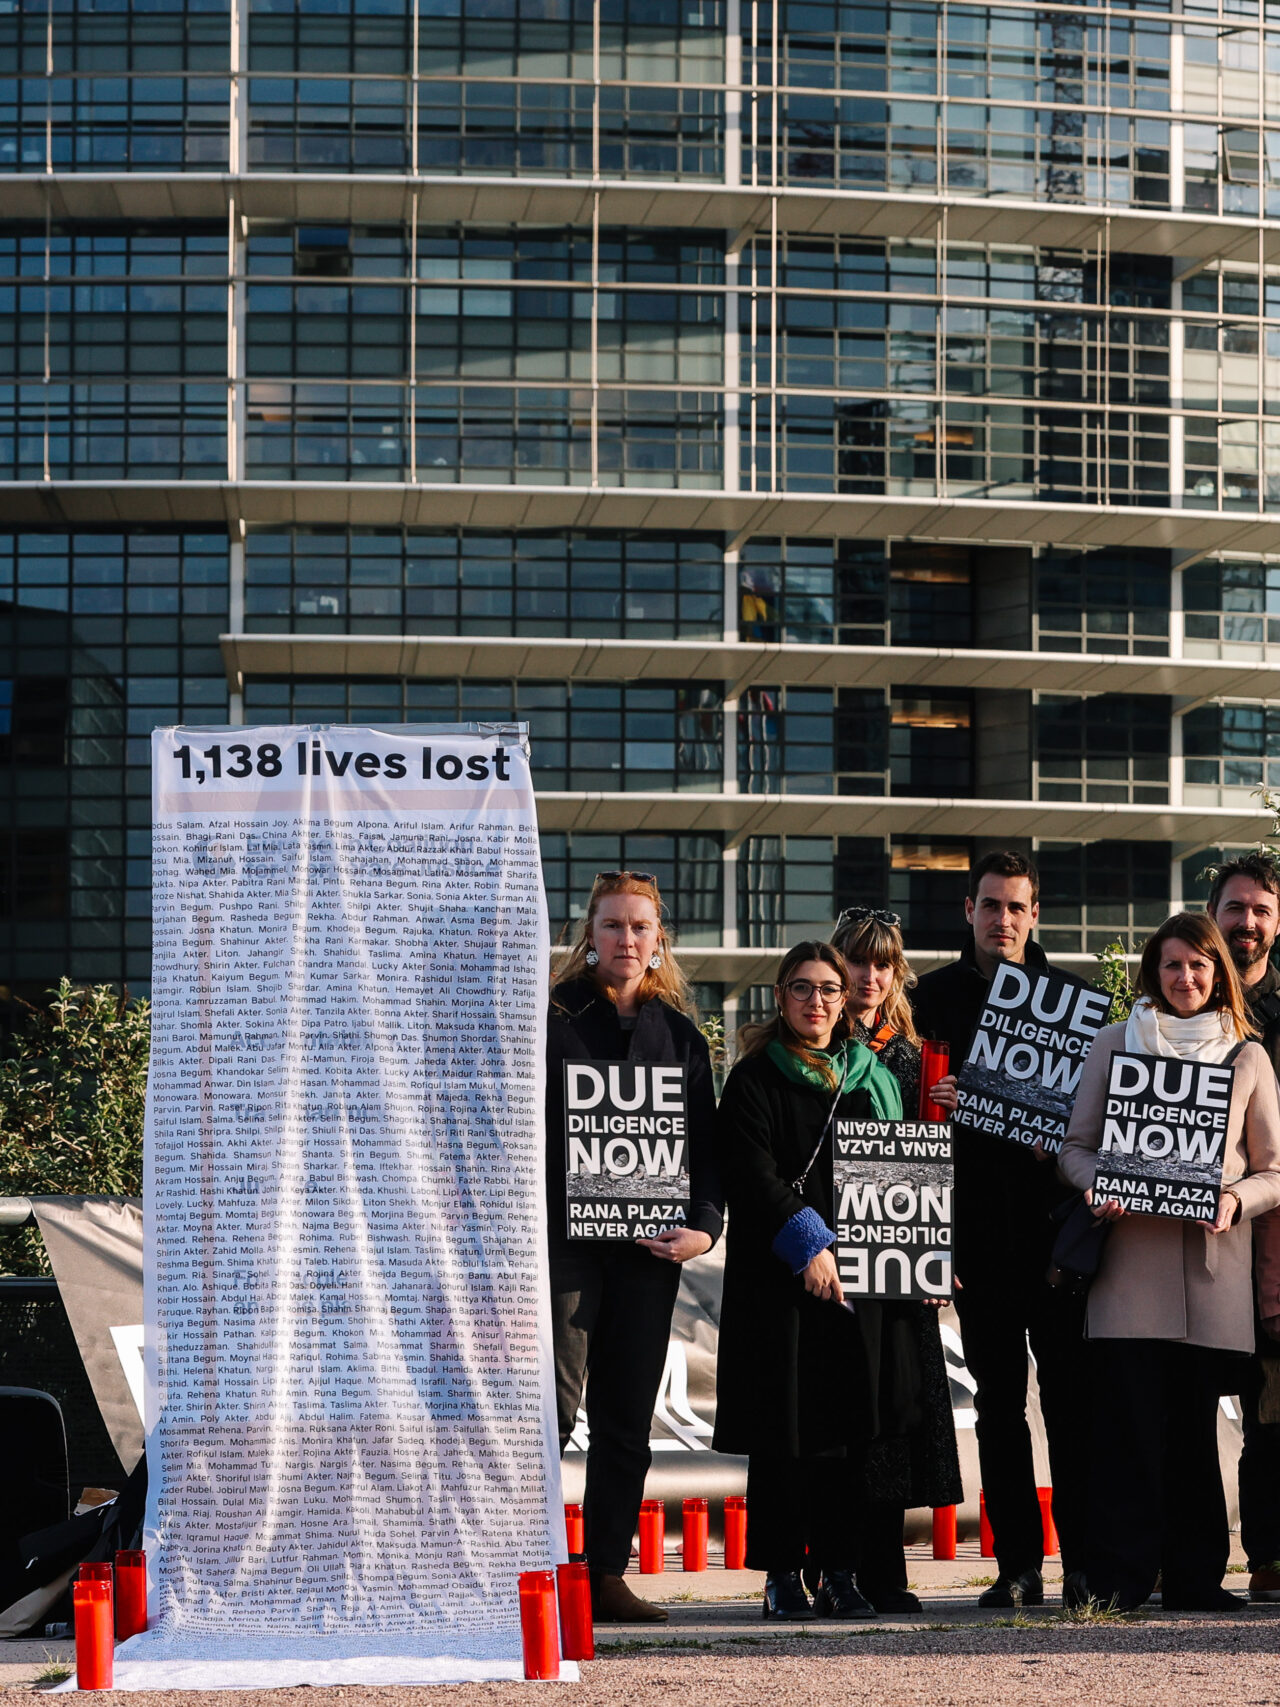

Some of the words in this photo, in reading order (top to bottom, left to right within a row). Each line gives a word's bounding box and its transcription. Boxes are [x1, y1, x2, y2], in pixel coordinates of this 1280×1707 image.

[173, 743, 283, 785] 1,138
[298, 741, 407, 779] lives
[422, 747, 510, 781] lost
[272, 820, 289, 828] Joy.
[324, 819, 353, 828] Begum
[357, 821, 389, 830] Alpona.
[422, 822, 445, 830] Islam.
[450, 823, 474, 831] Arifur
[186, 833, 211, 841] Bhagi
[216, 832, 235, 840] Rani
[326, 830, 354, 839] Ekhlas.
[359, 833, 385, 841] Faisal.
[234, 961, 260, 969] Akter.
[372, 962, 398, 971] Lucky
[430, 963, 456, 971] Sonia.
[461, 964, 510, 972] Mohammad
[186, 998, 247, 1006] Kamruzzaman
[363, 996, 411, 1005] Mohammad
[416, 998, 448, 1006] Shahin.
[452, 999, 484, 1007] Morjina
[489, 1000, 512, 1008] Akter
[988, 964, 1110, 1037] DUE
[981, 1010, 1092, 1057] DILIGENCE
[968, 1030, 1084, 1094] NOW
[567, 1065, 684, 1112] DUE
[1110, 1056, 1231, 1108] DUE
[957, 1090, 1002, 1117] RANA
[1009, 1108, 1064, 1137] PLAZA
[1107, 1100, 1226, 1128] DILIGENCE
[569, 1115, 684, 1135] DILIGENCE
[838, 1121, 890, 1136] AGAIN
[895, 1124, 950, 1138] NEVER
[954, 1110, 1004, 1135] NEVER
[838, 1139, 895, 1155] PLAZA
[901, 1142, 950, 1157] RANA
[1102, 1119, 1223, 1163] NOW
[568, 1138, 686, 1176] NOW
[155, 1166, 185, 1174] Begum.
[455, 1165, 487, 1173] Shahin.
[378, 1186, 409, 1194] Khushi.
[443, 1189, 459, 1197] Lipi
[490, 1190, 505, 1198] Lipi
[1096, 1176, 1148, 1195] RANA
[1155, 1184, 1215, 1203] PLAZA
[838, 1184, 951, 1222] NOW
[1158, 1202, 1214, 1219] AGAIN
[570, 1204, 622, 1219] RANA
[628, 1205, 686, 1220] PLAZA
[571, 1222, 628, 1237] NEVER
[633, 1224, 686, 1237] AGA
[837, 1224, 950, 1245] DILIGENCE
[838, 1248, 951, 1296] DUE
[157, 1308, 193, 1317] Faruque.
[234, 1307, 258, 1315] Ripon
[391, 1306, 422, 1315] Begum.
[425, 1307, 457, 1315] Shapan
[157, 1321, 183, 1329] Suriya
[224, 1318, 255, 1326] Nasima
[474, 1319, 507, 1327] Khatun.
[162, 1464, 183, 1472] Selim
[208, 1462, 257, 1470] Mohammad
[415, 1461, 448, 1469] Begum.
[182, 1497, 218, 1505] Hossain.
[241, 1568, 267, 1576] Najma
[520, 1559, 553, 1567] Begum.
